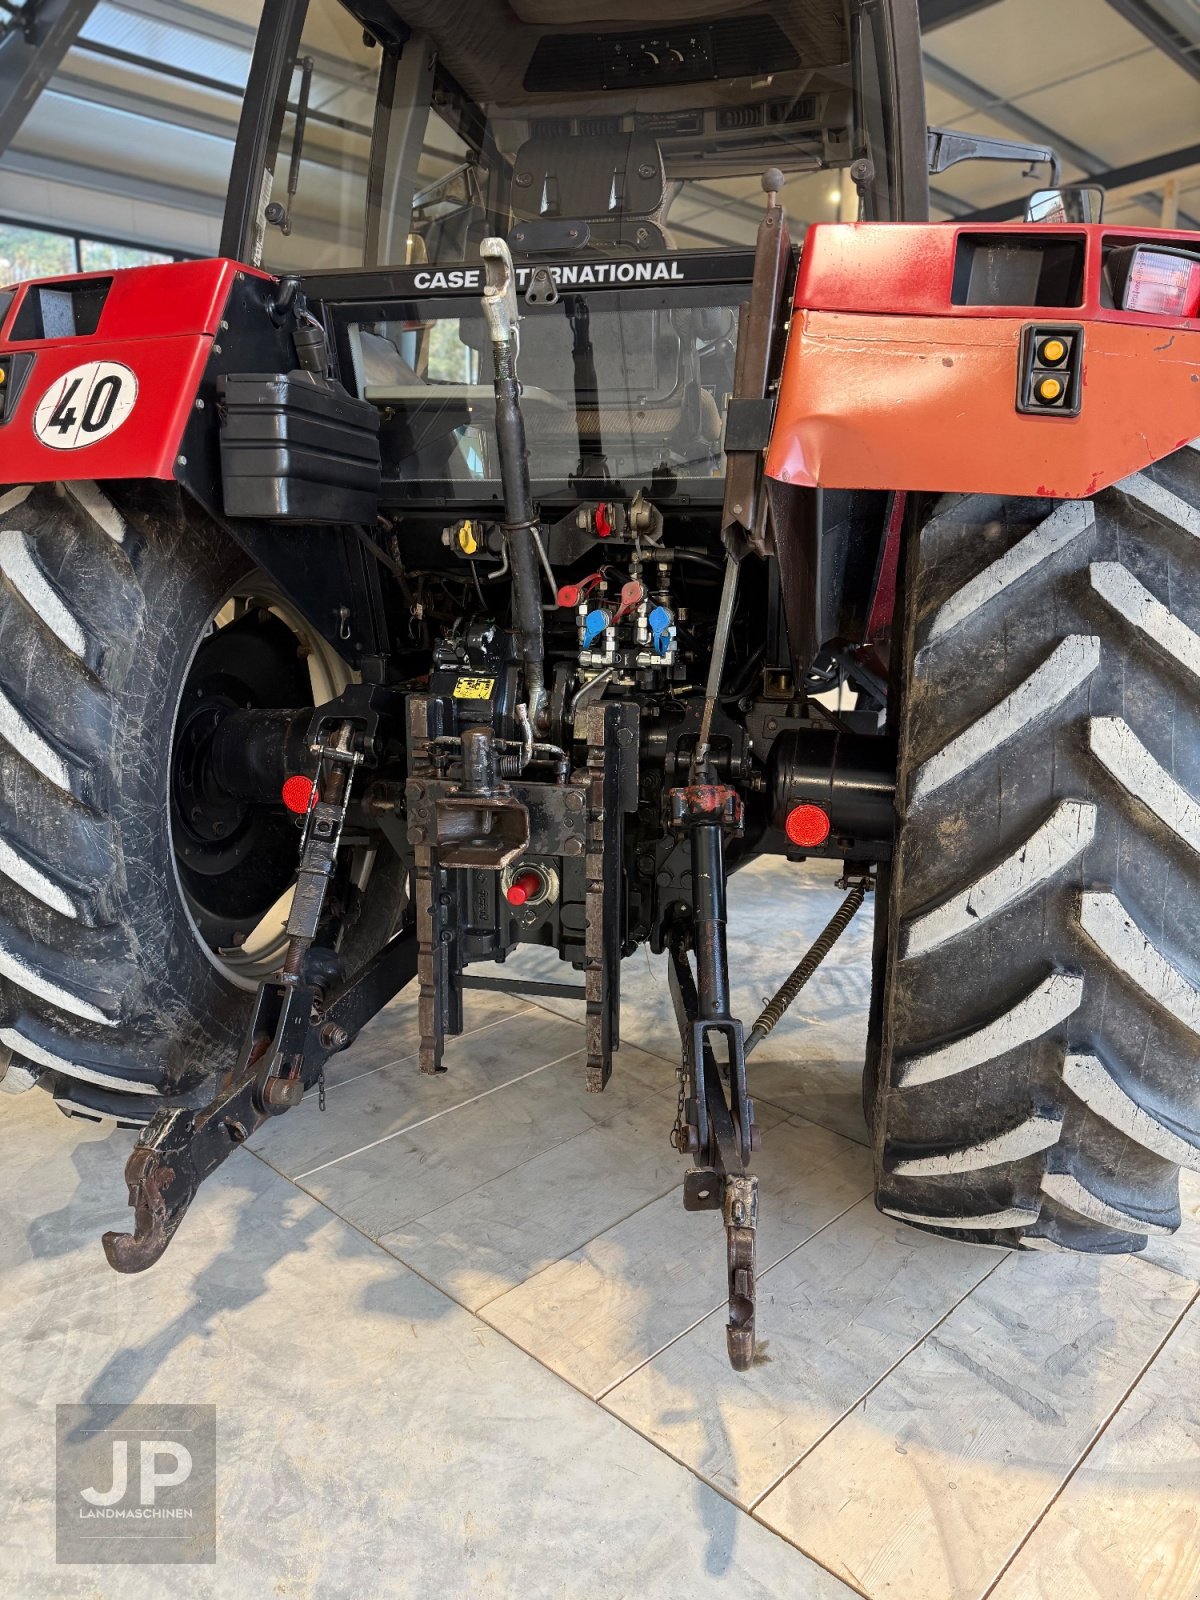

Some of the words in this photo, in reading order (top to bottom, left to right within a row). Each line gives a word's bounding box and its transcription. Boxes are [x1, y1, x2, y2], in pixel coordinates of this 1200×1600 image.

[414, 270, 480, 290] CASE
[515, 262, 684, 286] TRNATIONAL
[48, 375, 122, 434] 40
